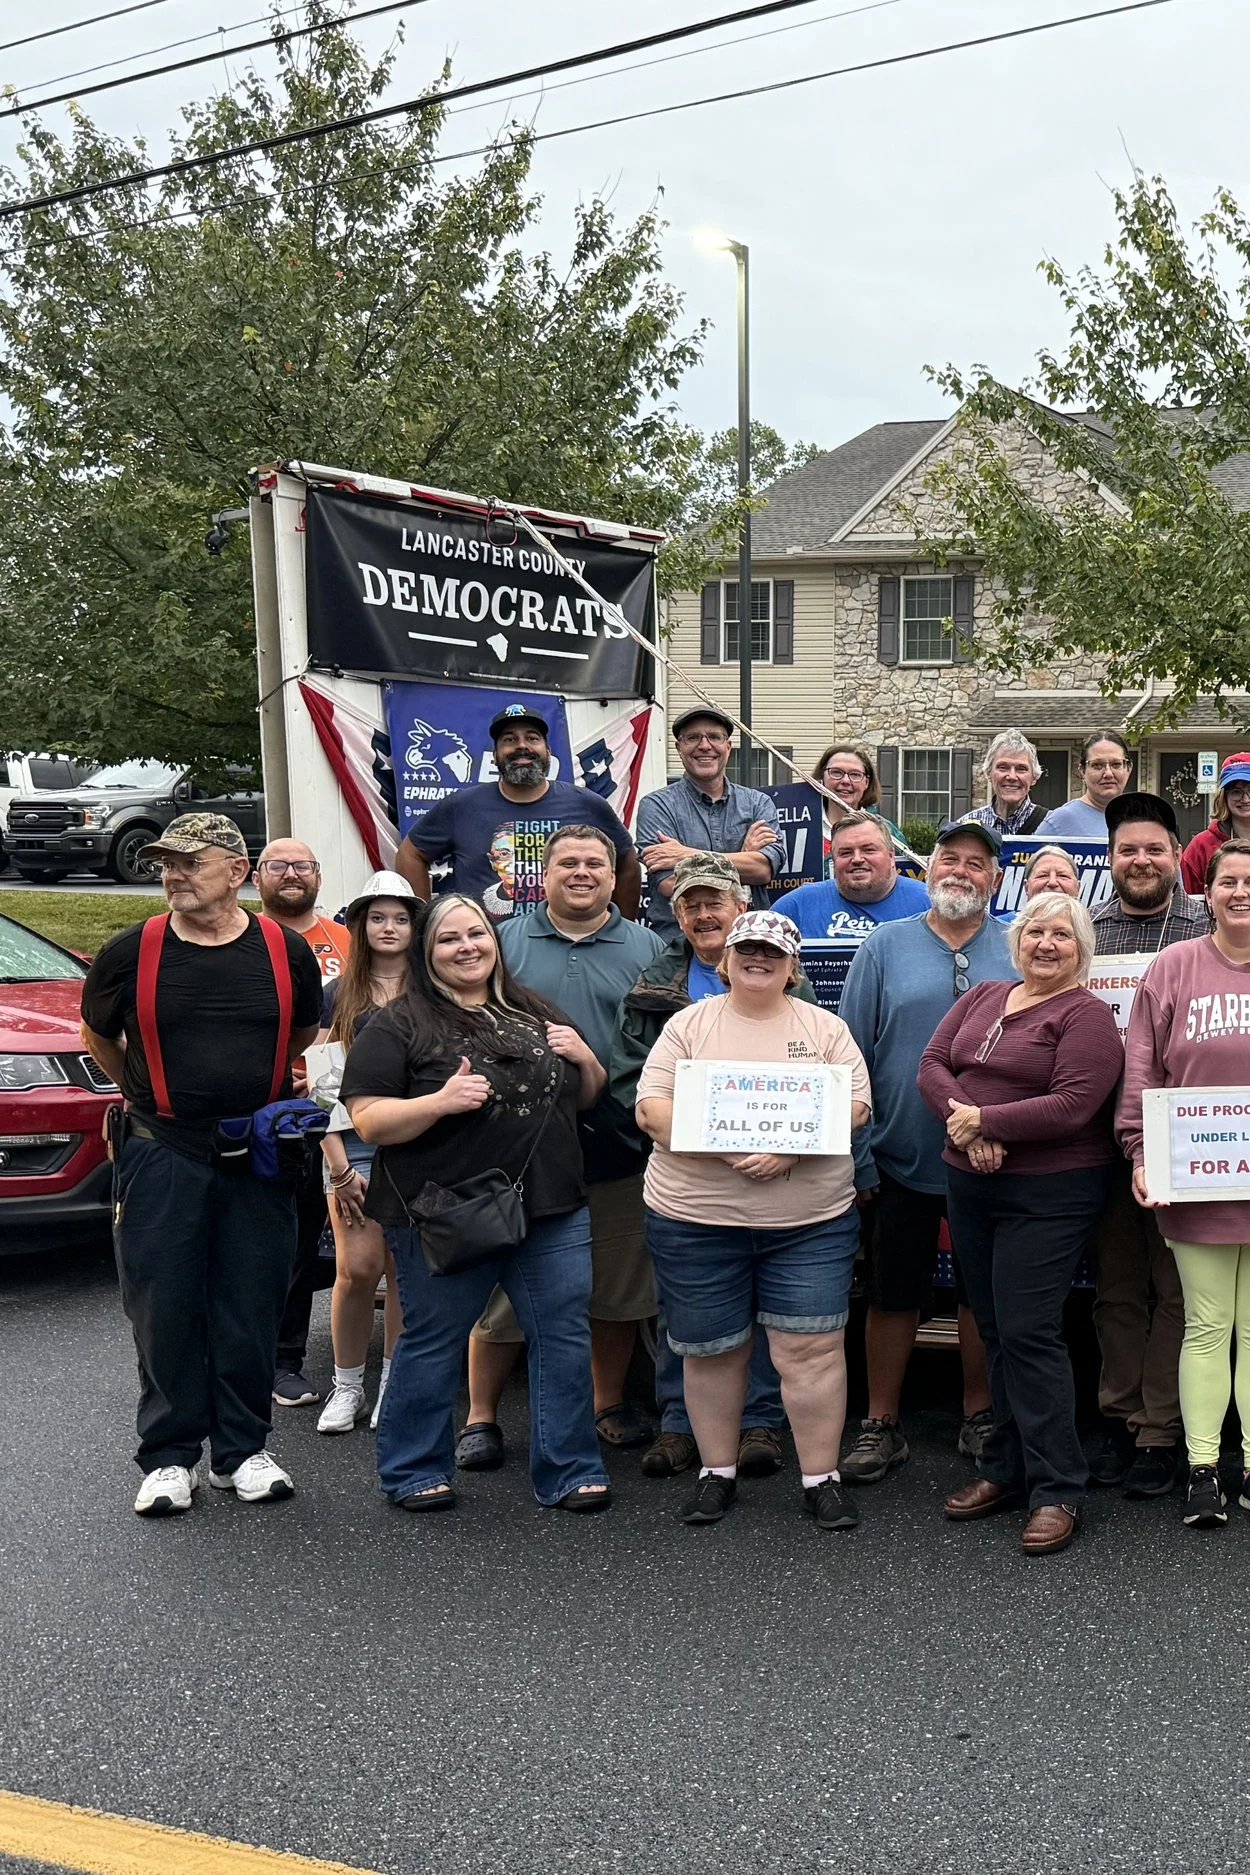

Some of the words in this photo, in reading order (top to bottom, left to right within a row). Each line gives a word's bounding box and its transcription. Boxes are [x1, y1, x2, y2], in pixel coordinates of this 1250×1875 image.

[401, 527, 514, 568] LANCASTER
[357, 562, 631, 640] DEMOCRATS
[403, 786, 460, 800] EPHRAT
[777, 805, 812, 824] ELLA
[515, 821, 560, 833] FIGHT
[515, 833, 545, 847] FOR
[514, 888, 547, 902] CAR
[1085, 976, 1140, 990] RKERS
[1196, 1027, 1235, 1043] DEWEY
[724, 1078, 812, 1093] AMERICA
[746, 1102, 759, 1110] IS
[763, 1102, 788, 1111] FOR
[1177, 1105, 1208, 1117] DUE
[716, 1119, 752, 1132] ALL
[758, 1120, 784, 1132] OF
[790, 1121, 816, 1133] US
[1191, 1131, 1238, 1143] UNDER
[1189, 1159, 1230, 1175] FOR
